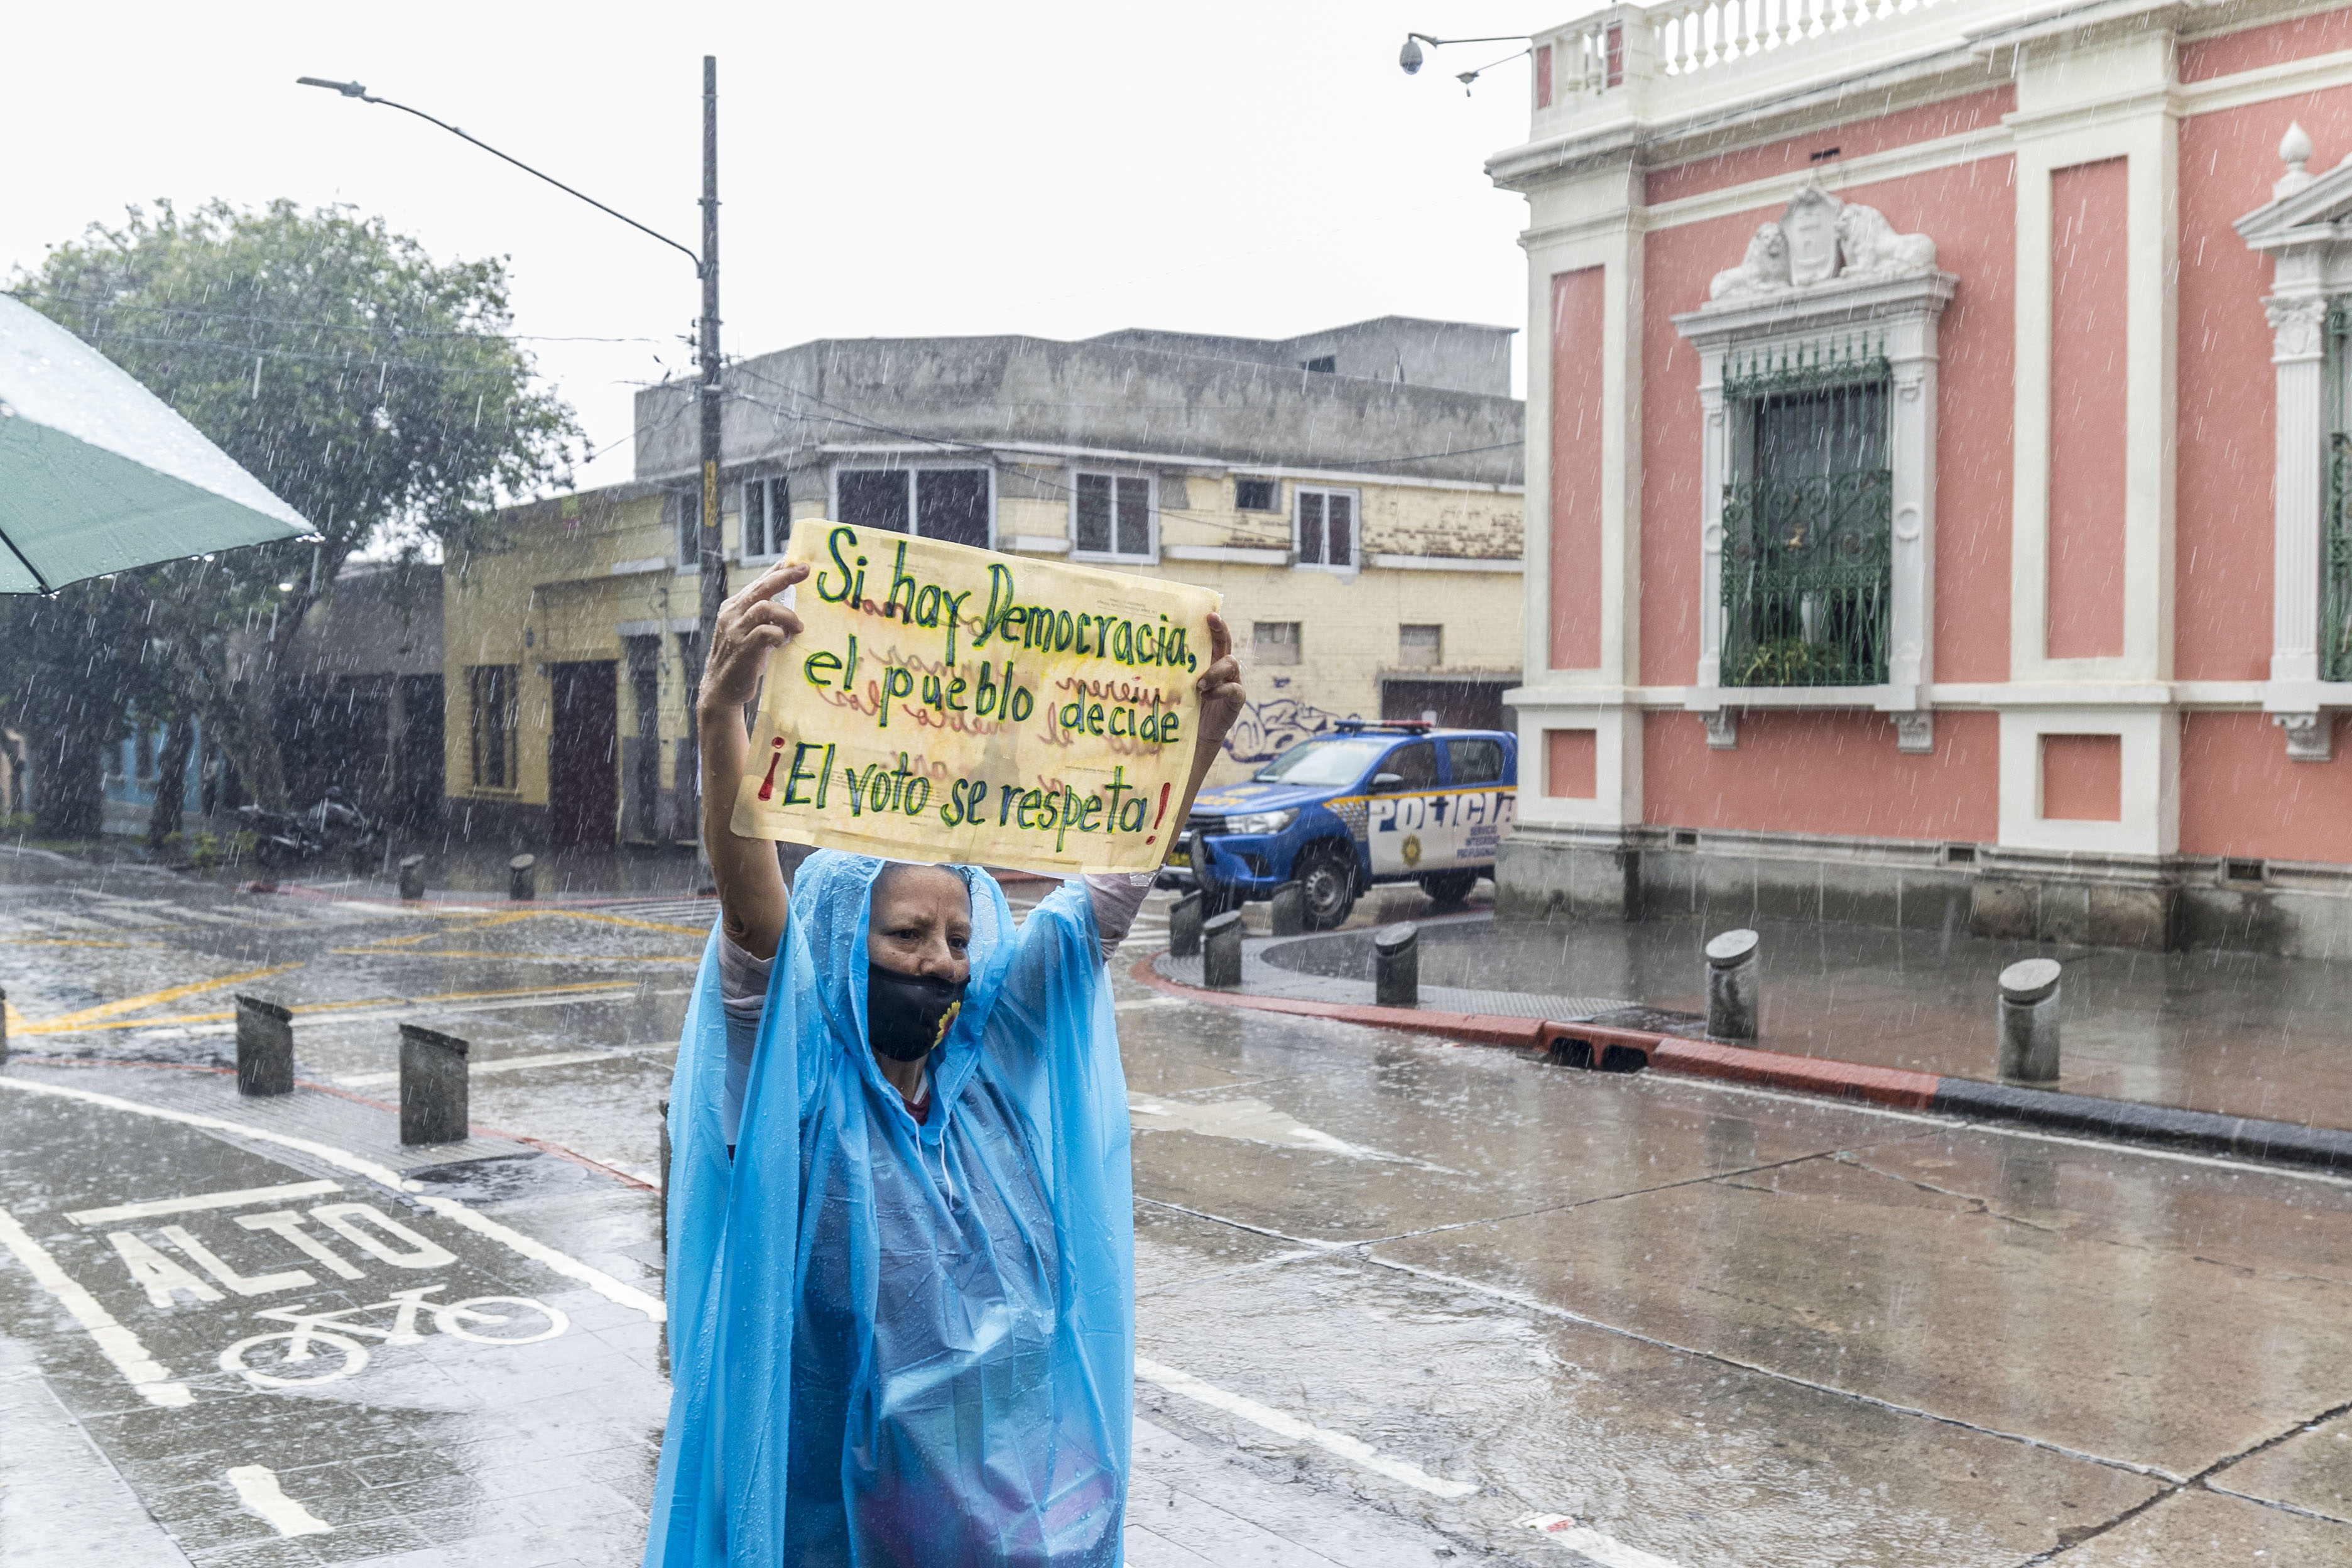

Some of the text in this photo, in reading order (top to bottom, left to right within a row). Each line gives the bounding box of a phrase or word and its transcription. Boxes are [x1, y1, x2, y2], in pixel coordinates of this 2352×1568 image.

[817, 526, 1197, 673] Si hay Democracia,
[805, 634, 858, 690] el
[879, 661, 1034, 727] pueblo
[1059, 677, 1180, 744] decide
[758, 736, 836, 810] ¡El
[845, 751, 932, 817] voto
[940, 778, 988, 827] se
[1000, 765, 1172, 852] respeta!
[107, 1202, 459, 1309] ALTO
